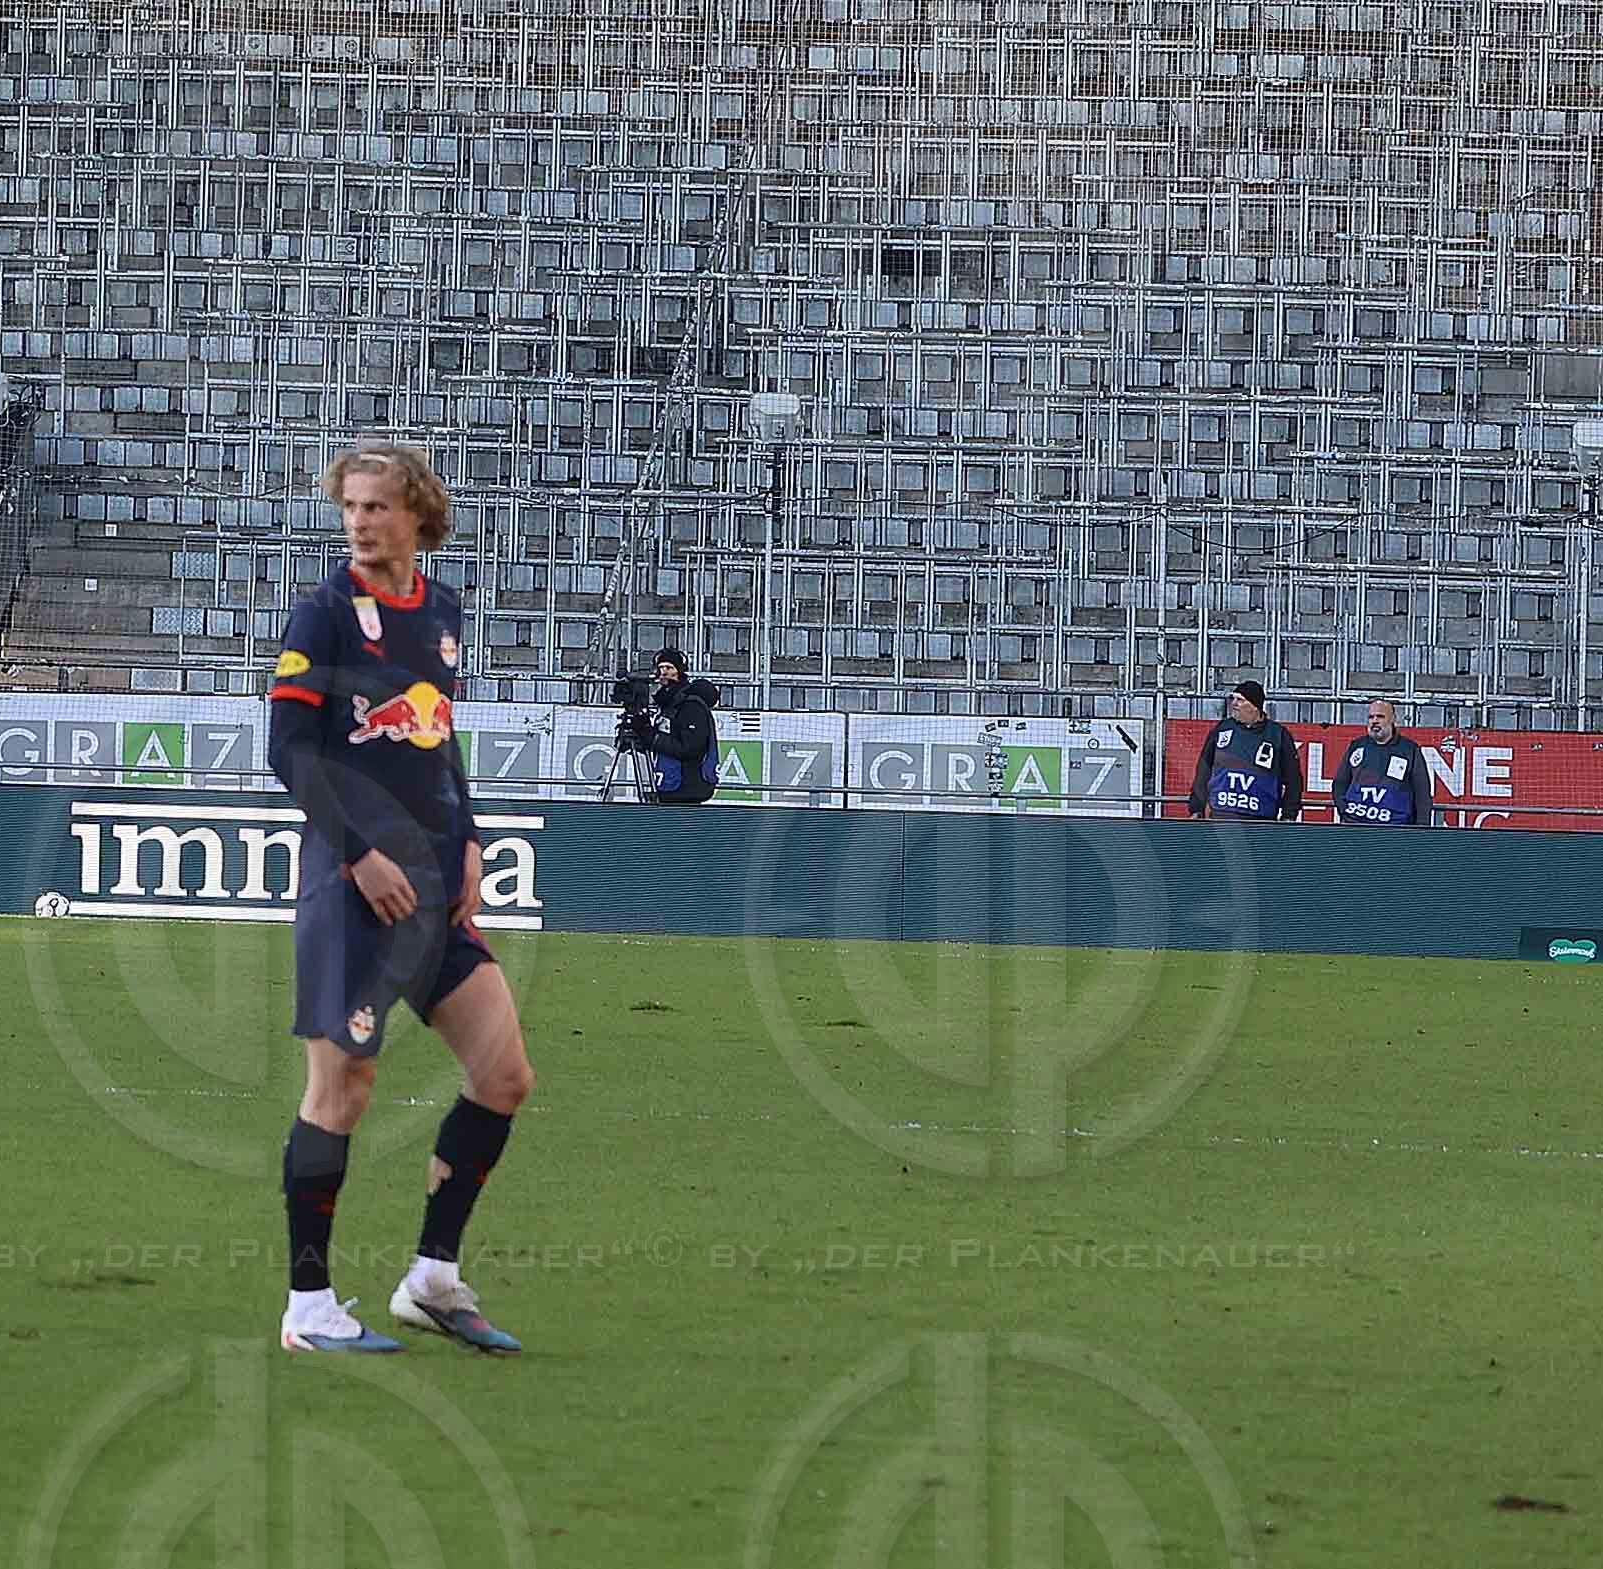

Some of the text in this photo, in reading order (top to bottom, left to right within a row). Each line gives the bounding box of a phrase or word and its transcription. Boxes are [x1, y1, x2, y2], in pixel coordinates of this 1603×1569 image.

[1226, 771, 1255, 792] TV
[1217, 791, 1260, 811] 9526
[1360, 786, 1388, 804] TV
